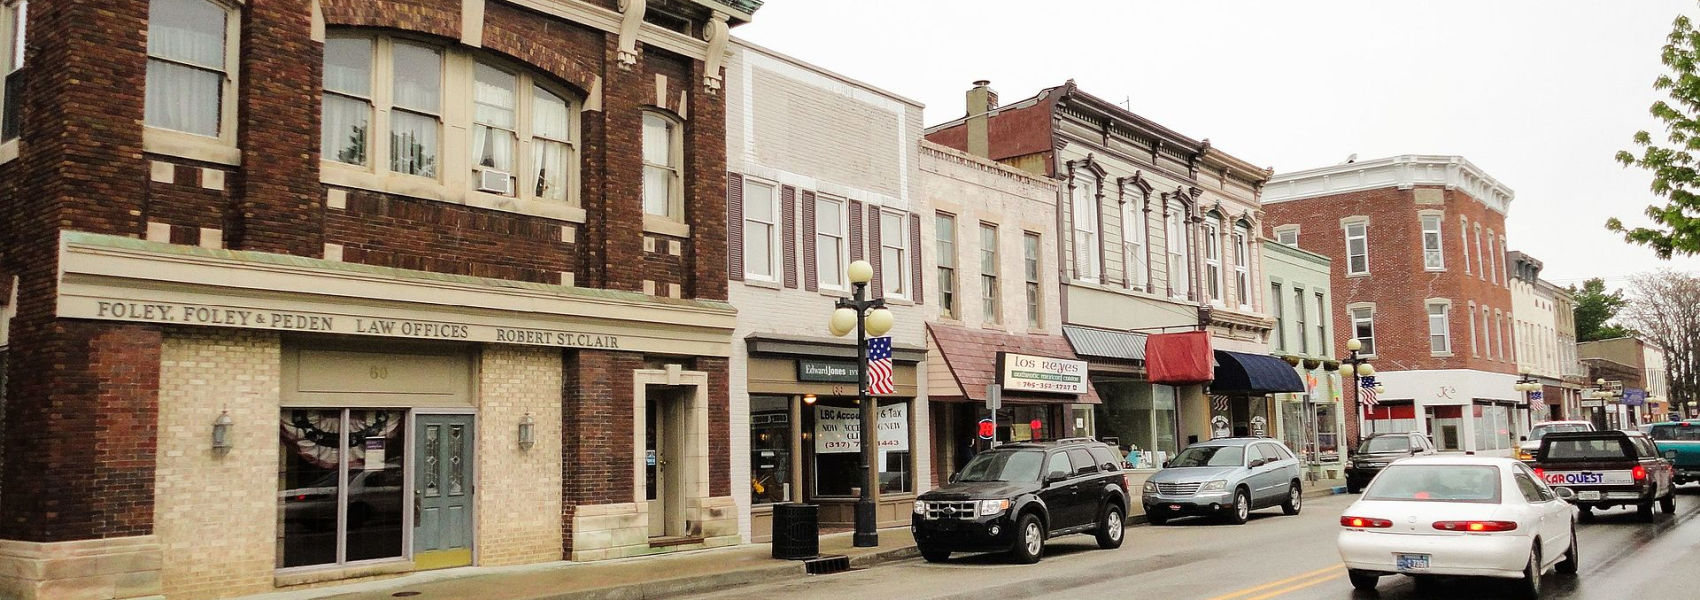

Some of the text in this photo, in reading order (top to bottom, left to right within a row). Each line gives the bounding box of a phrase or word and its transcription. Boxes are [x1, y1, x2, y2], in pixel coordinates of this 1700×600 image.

[183, 306, 251, 326] FOLEY
[255, 313, 265, 324] &
[270, 312, 333, 331] PEDEN
[356, 318, 469, 338] LAW OFFICES
[496, 328, 552, 344] ROBERT
[888, 408, 902, 418] Tax
[884, 422, 900, 431] NEW
